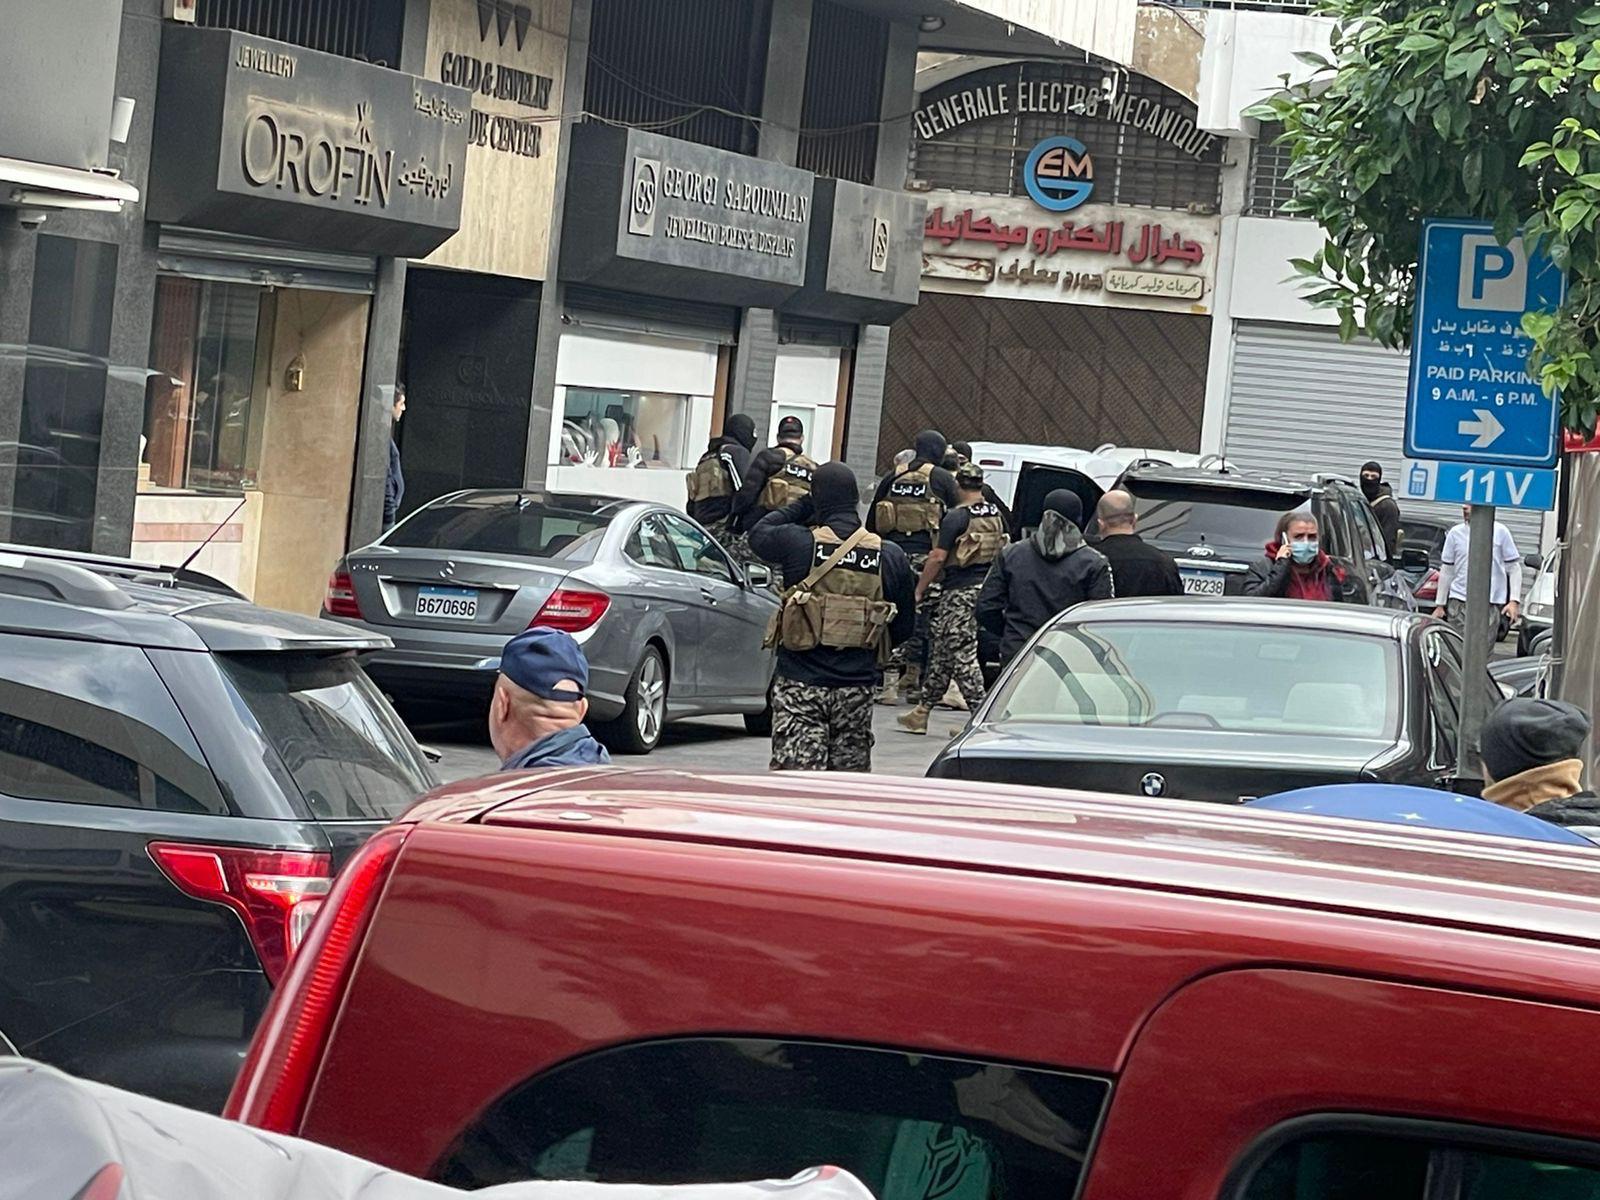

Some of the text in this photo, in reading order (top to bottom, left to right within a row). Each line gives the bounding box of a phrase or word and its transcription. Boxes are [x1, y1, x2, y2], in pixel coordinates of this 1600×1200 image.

[237, 46, 297, 78] JEWELLERY
[440, 51, 482, 92] GOLD
[481, 62, 494, 96] &
[490, 115, 542, 158] CENTER
[914, 82, 1218, 161] GENERALE ELECTRO MECANIQUE
[241, 106, 396, 208] OROFIN
[634, 179, 656, 215] GS
[662, 166, 809, 223] GEORGI SABOUNJIAN
[1128, 224, 1205, 265] جنرال
[1472, 245, 1515, 299] P
[1431, 318, 1458, 336] بدل
[1460, 319, 1496, 337] مقابل
[1427, 366, 1464, 381] PAID
[1432, 387, 1441, 400] 9
[1445, 388, 1478, 402] A.M.
[1495, 393, 1504, 406] 6
[1508, 392, 1538, 406] P.M.
[1459, 468, 1534, 505] 11 V
[418, 598, 476, 616] B670696
